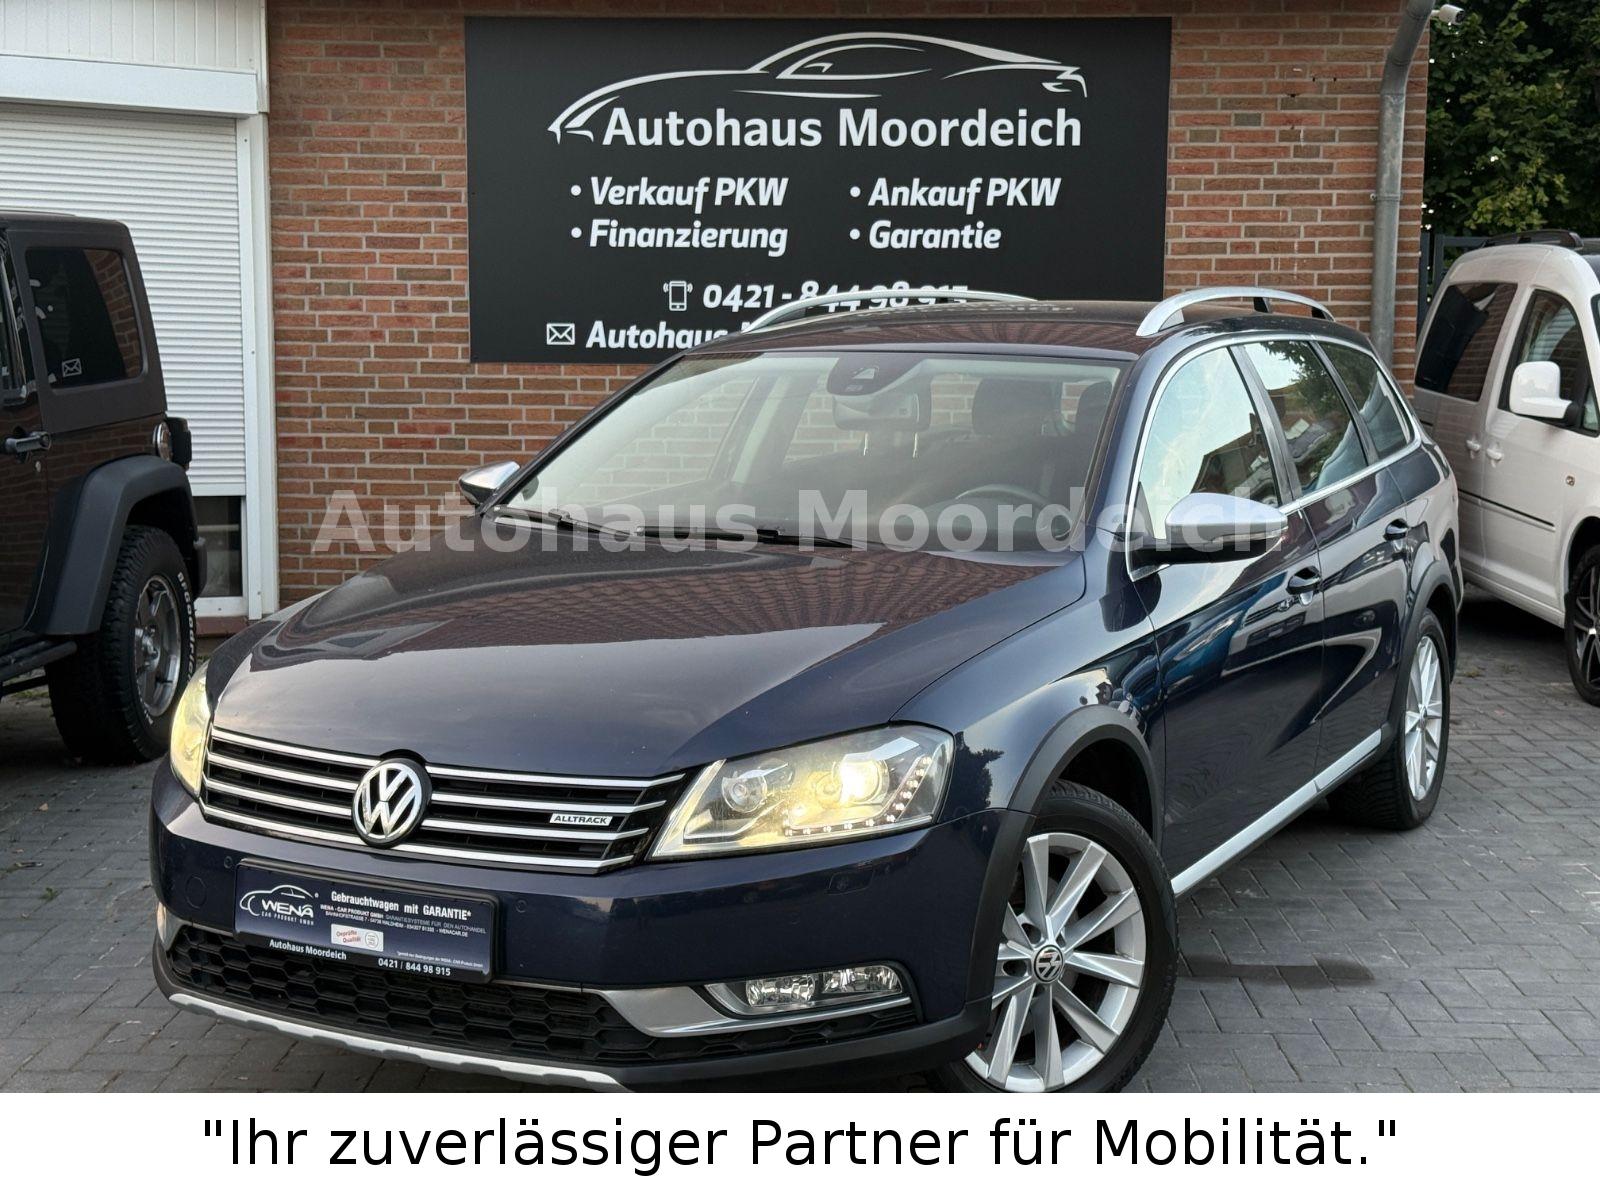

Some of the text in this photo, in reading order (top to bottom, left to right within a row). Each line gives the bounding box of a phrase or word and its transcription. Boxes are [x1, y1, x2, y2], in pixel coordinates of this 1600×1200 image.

[602, 107, 1082, 147] Autohaus Moordeich
[590, 177, 789, 214] Verkauf PKW
[868, 178, 1062, 214] Ankauf PKW
[590, 219, 789, 258] Finanzierung
[869, 220, 1002, 249] Garantie
[703, 284, 774, 313] 0421
[553, 815, 608, 825] ALLTRACK
[331, 891, 399, 911] Gebrauchtwagen
[404, 903, 419, 914] mit
[269, 939, 347, 960] Autohaus Moordeich
[378, 958, 398, 969] 0421
[405, 962, 421, 972] 844
[423, 965, 433, 974] 98
[436, 967, 451, 976] 915
